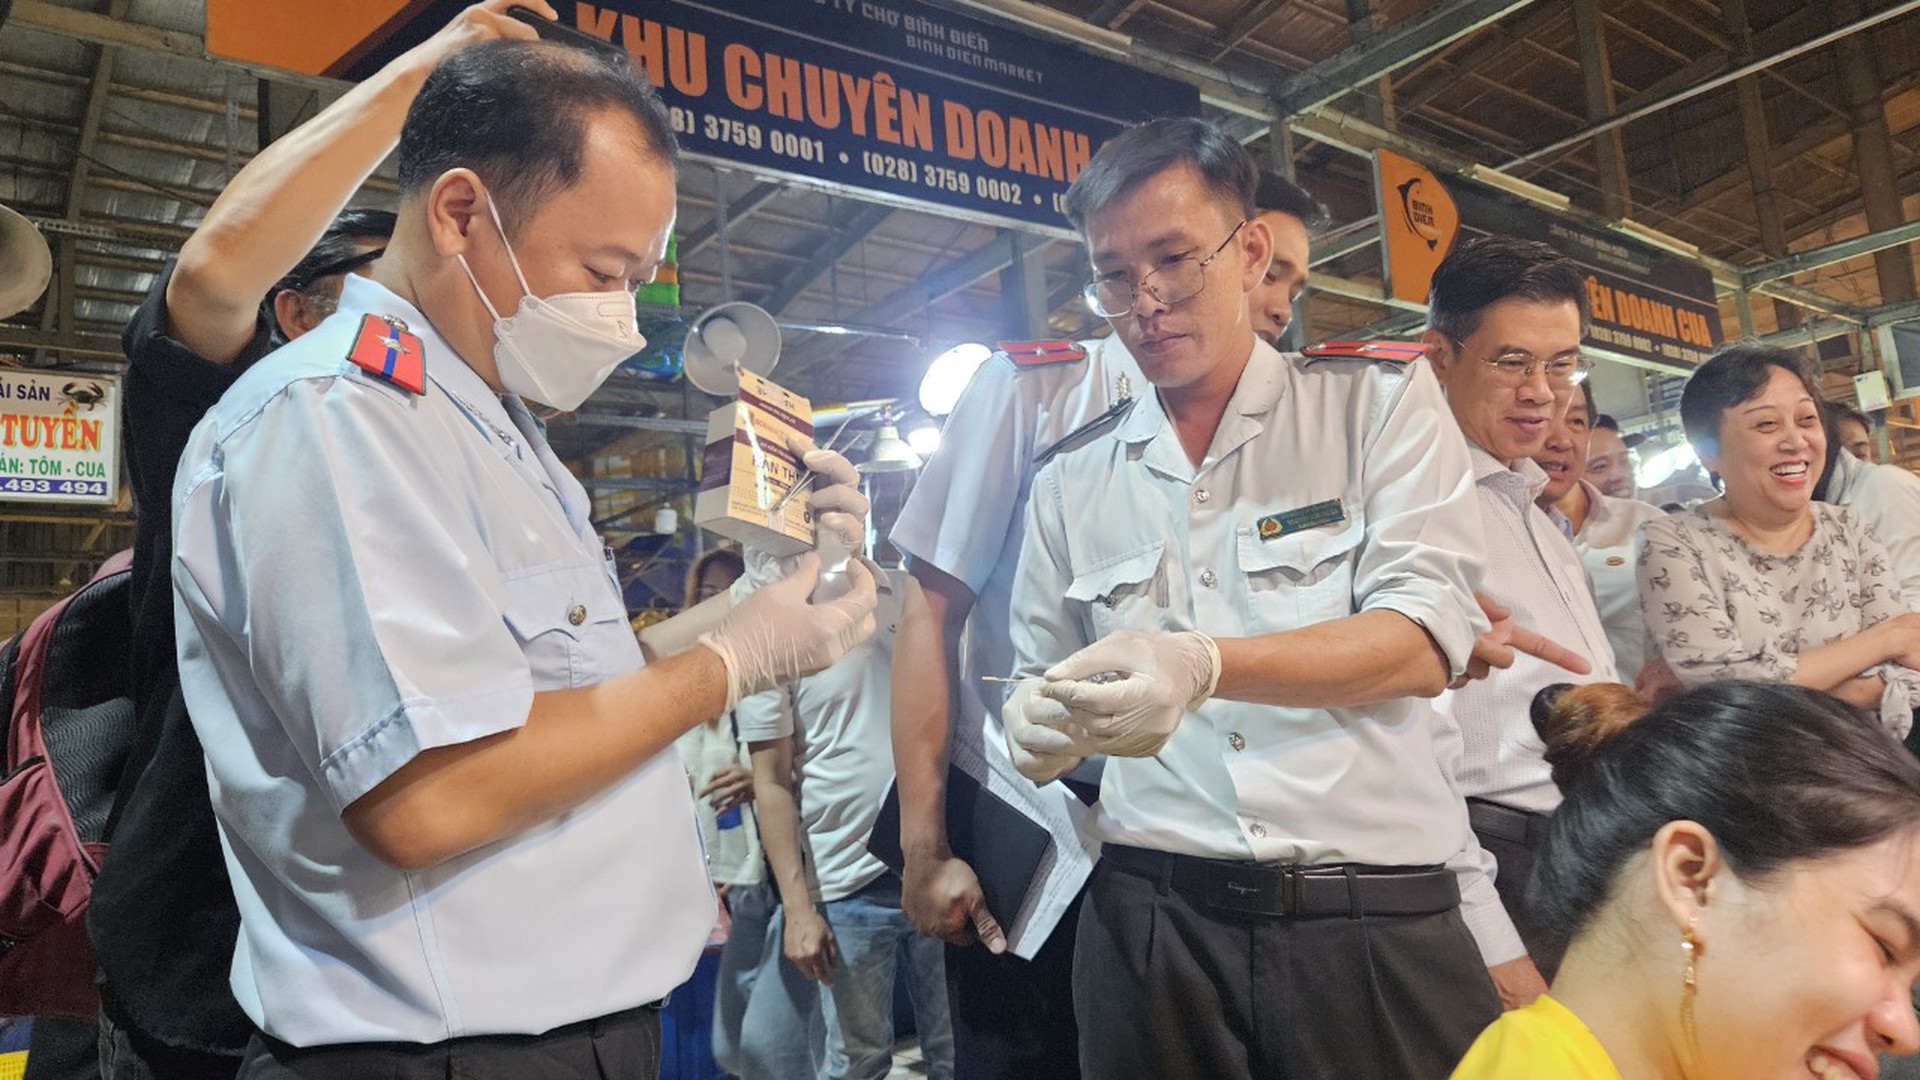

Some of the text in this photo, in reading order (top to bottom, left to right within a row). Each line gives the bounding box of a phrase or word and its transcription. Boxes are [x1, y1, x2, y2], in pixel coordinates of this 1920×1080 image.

[723, 43, 933, 152] CHUYÊN
[943, 100, 1092, 184] DOANH
[704, 113, 762, 150] 3759
[770, 130, 824, 164] 0001
[863, 152, 917, 183] (028)
[924, 165, 970, 195] 3759
[977, 176, 1022, 205] 0002
[1584, 275, 1616, 322] ÊN
[1614, 289, 1679, 339] DOANH
[17, 379, 50, 401] SẢN
[29, 455, 61, 475] TÔM
[75, 461, 105, 478] CUA
[59, 481, 104, 494] 494
